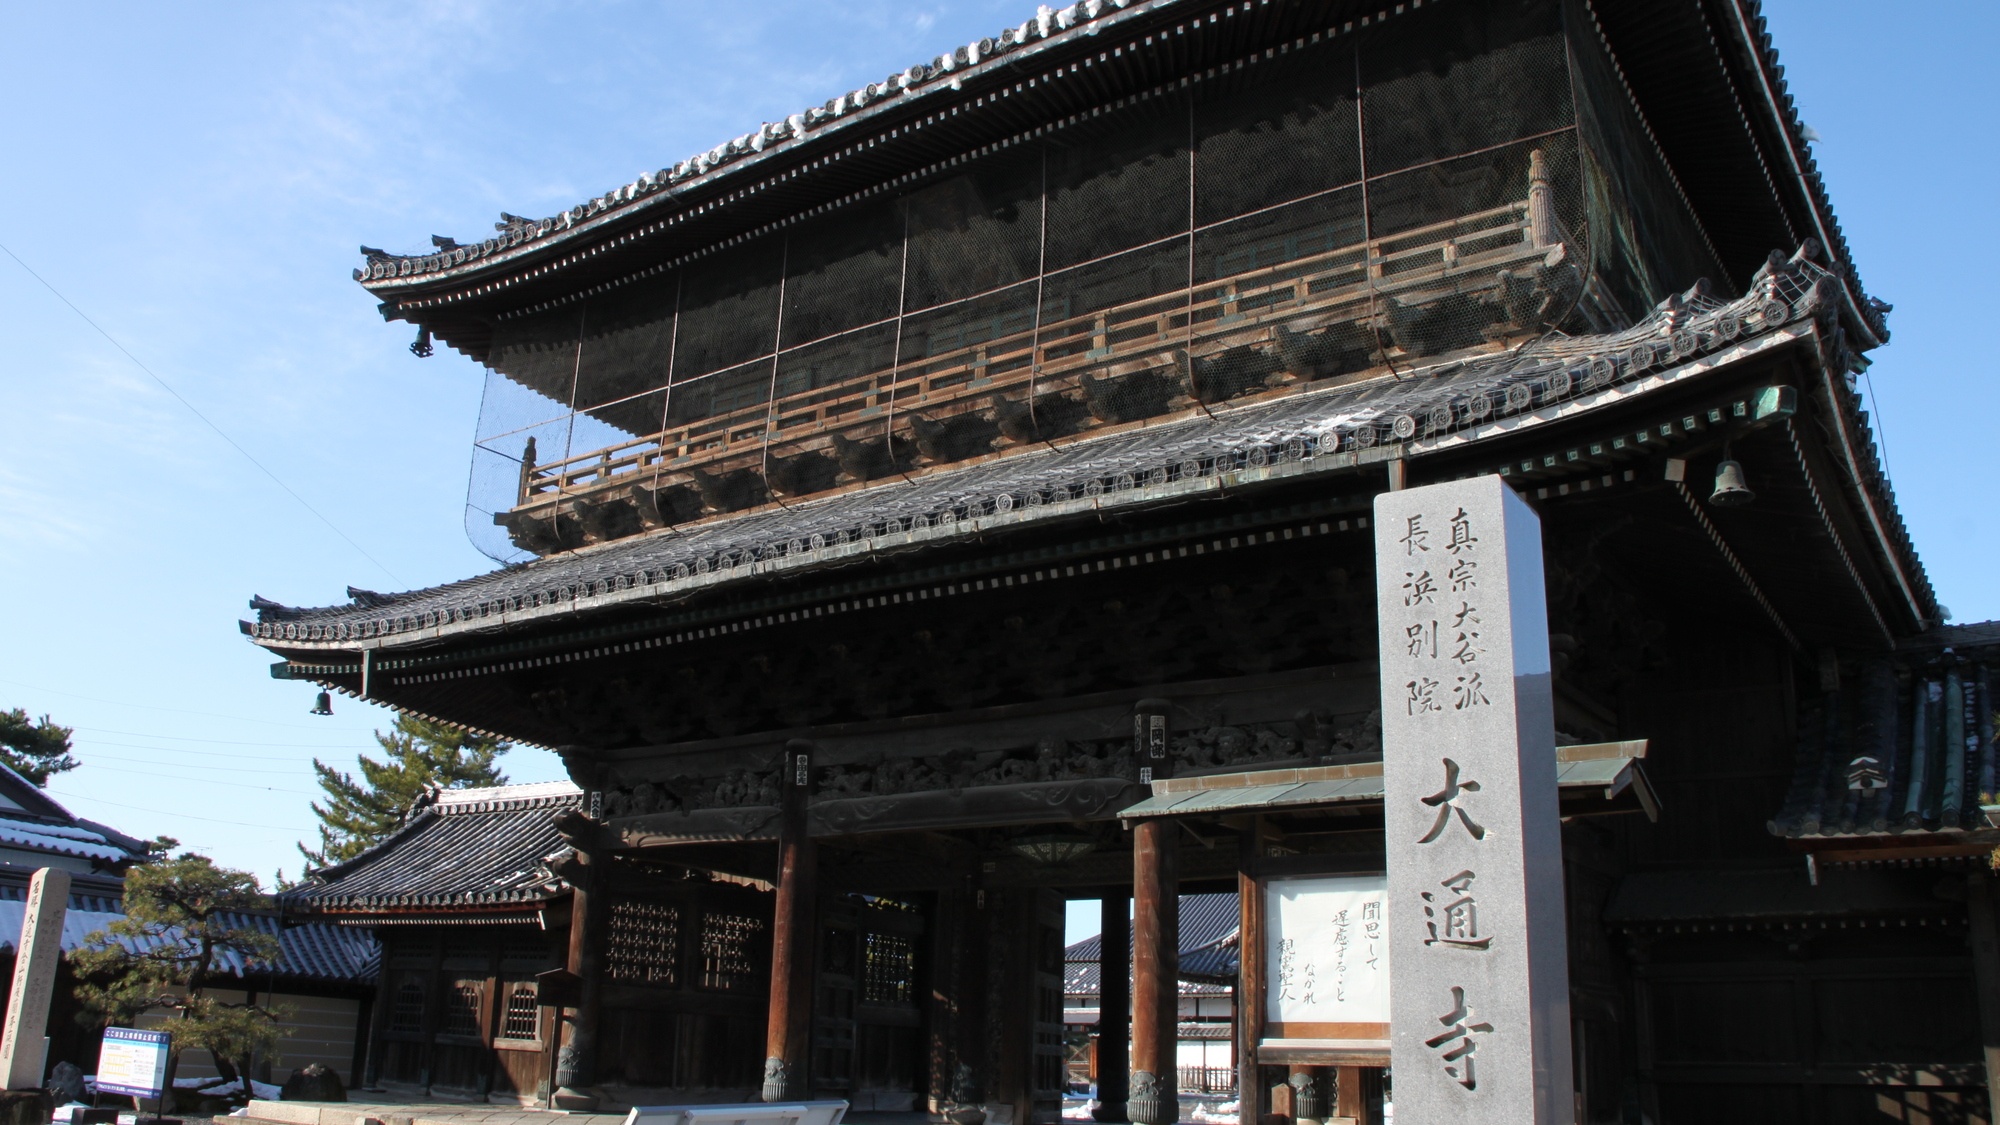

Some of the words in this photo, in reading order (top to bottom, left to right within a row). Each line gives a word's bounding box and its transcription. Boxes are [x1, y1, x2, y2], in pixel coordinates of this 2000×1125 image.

[1399, 513, 1442, 716] 長浜別院
[1445, 507, 1490, 710] 真宗大谷派
[1276, 938, 1296, 1001] 親鸞聖人
[1303, 963, 1317, 1005] なかれ
[1362, 901, 1381, 970] 聞思して
[1416, 757, 1495, 1091] 大通寺
